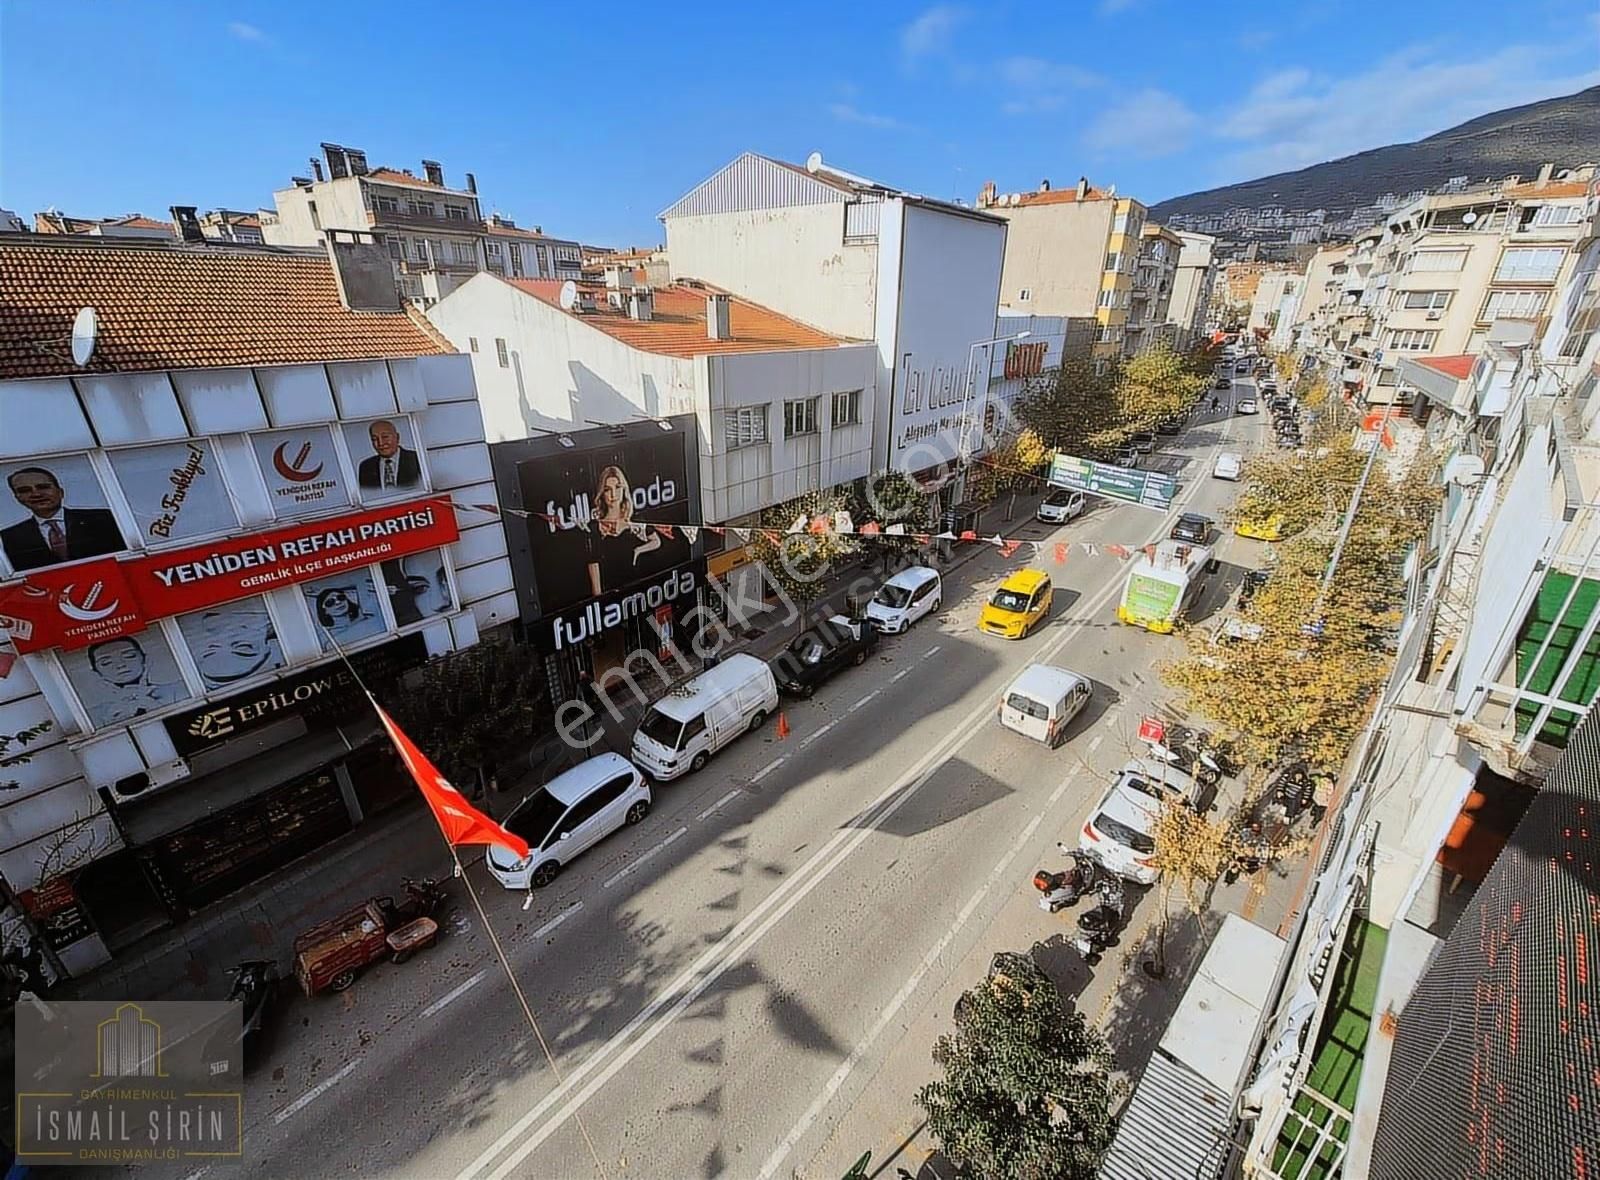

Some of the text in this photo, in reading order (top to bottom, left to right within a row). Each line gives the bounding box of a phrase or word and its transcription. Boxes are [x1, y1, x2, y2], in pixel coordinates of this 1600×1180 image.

[150, 510, 177, 538] Biz
[153, 506, 435, 588] YENİDEN REFAH PARTİSİ
[240, 542, 392, 589] GEMLİK İLÇE BAŞKANLIĞI
[552, 569, 696, 651] fullamoda
